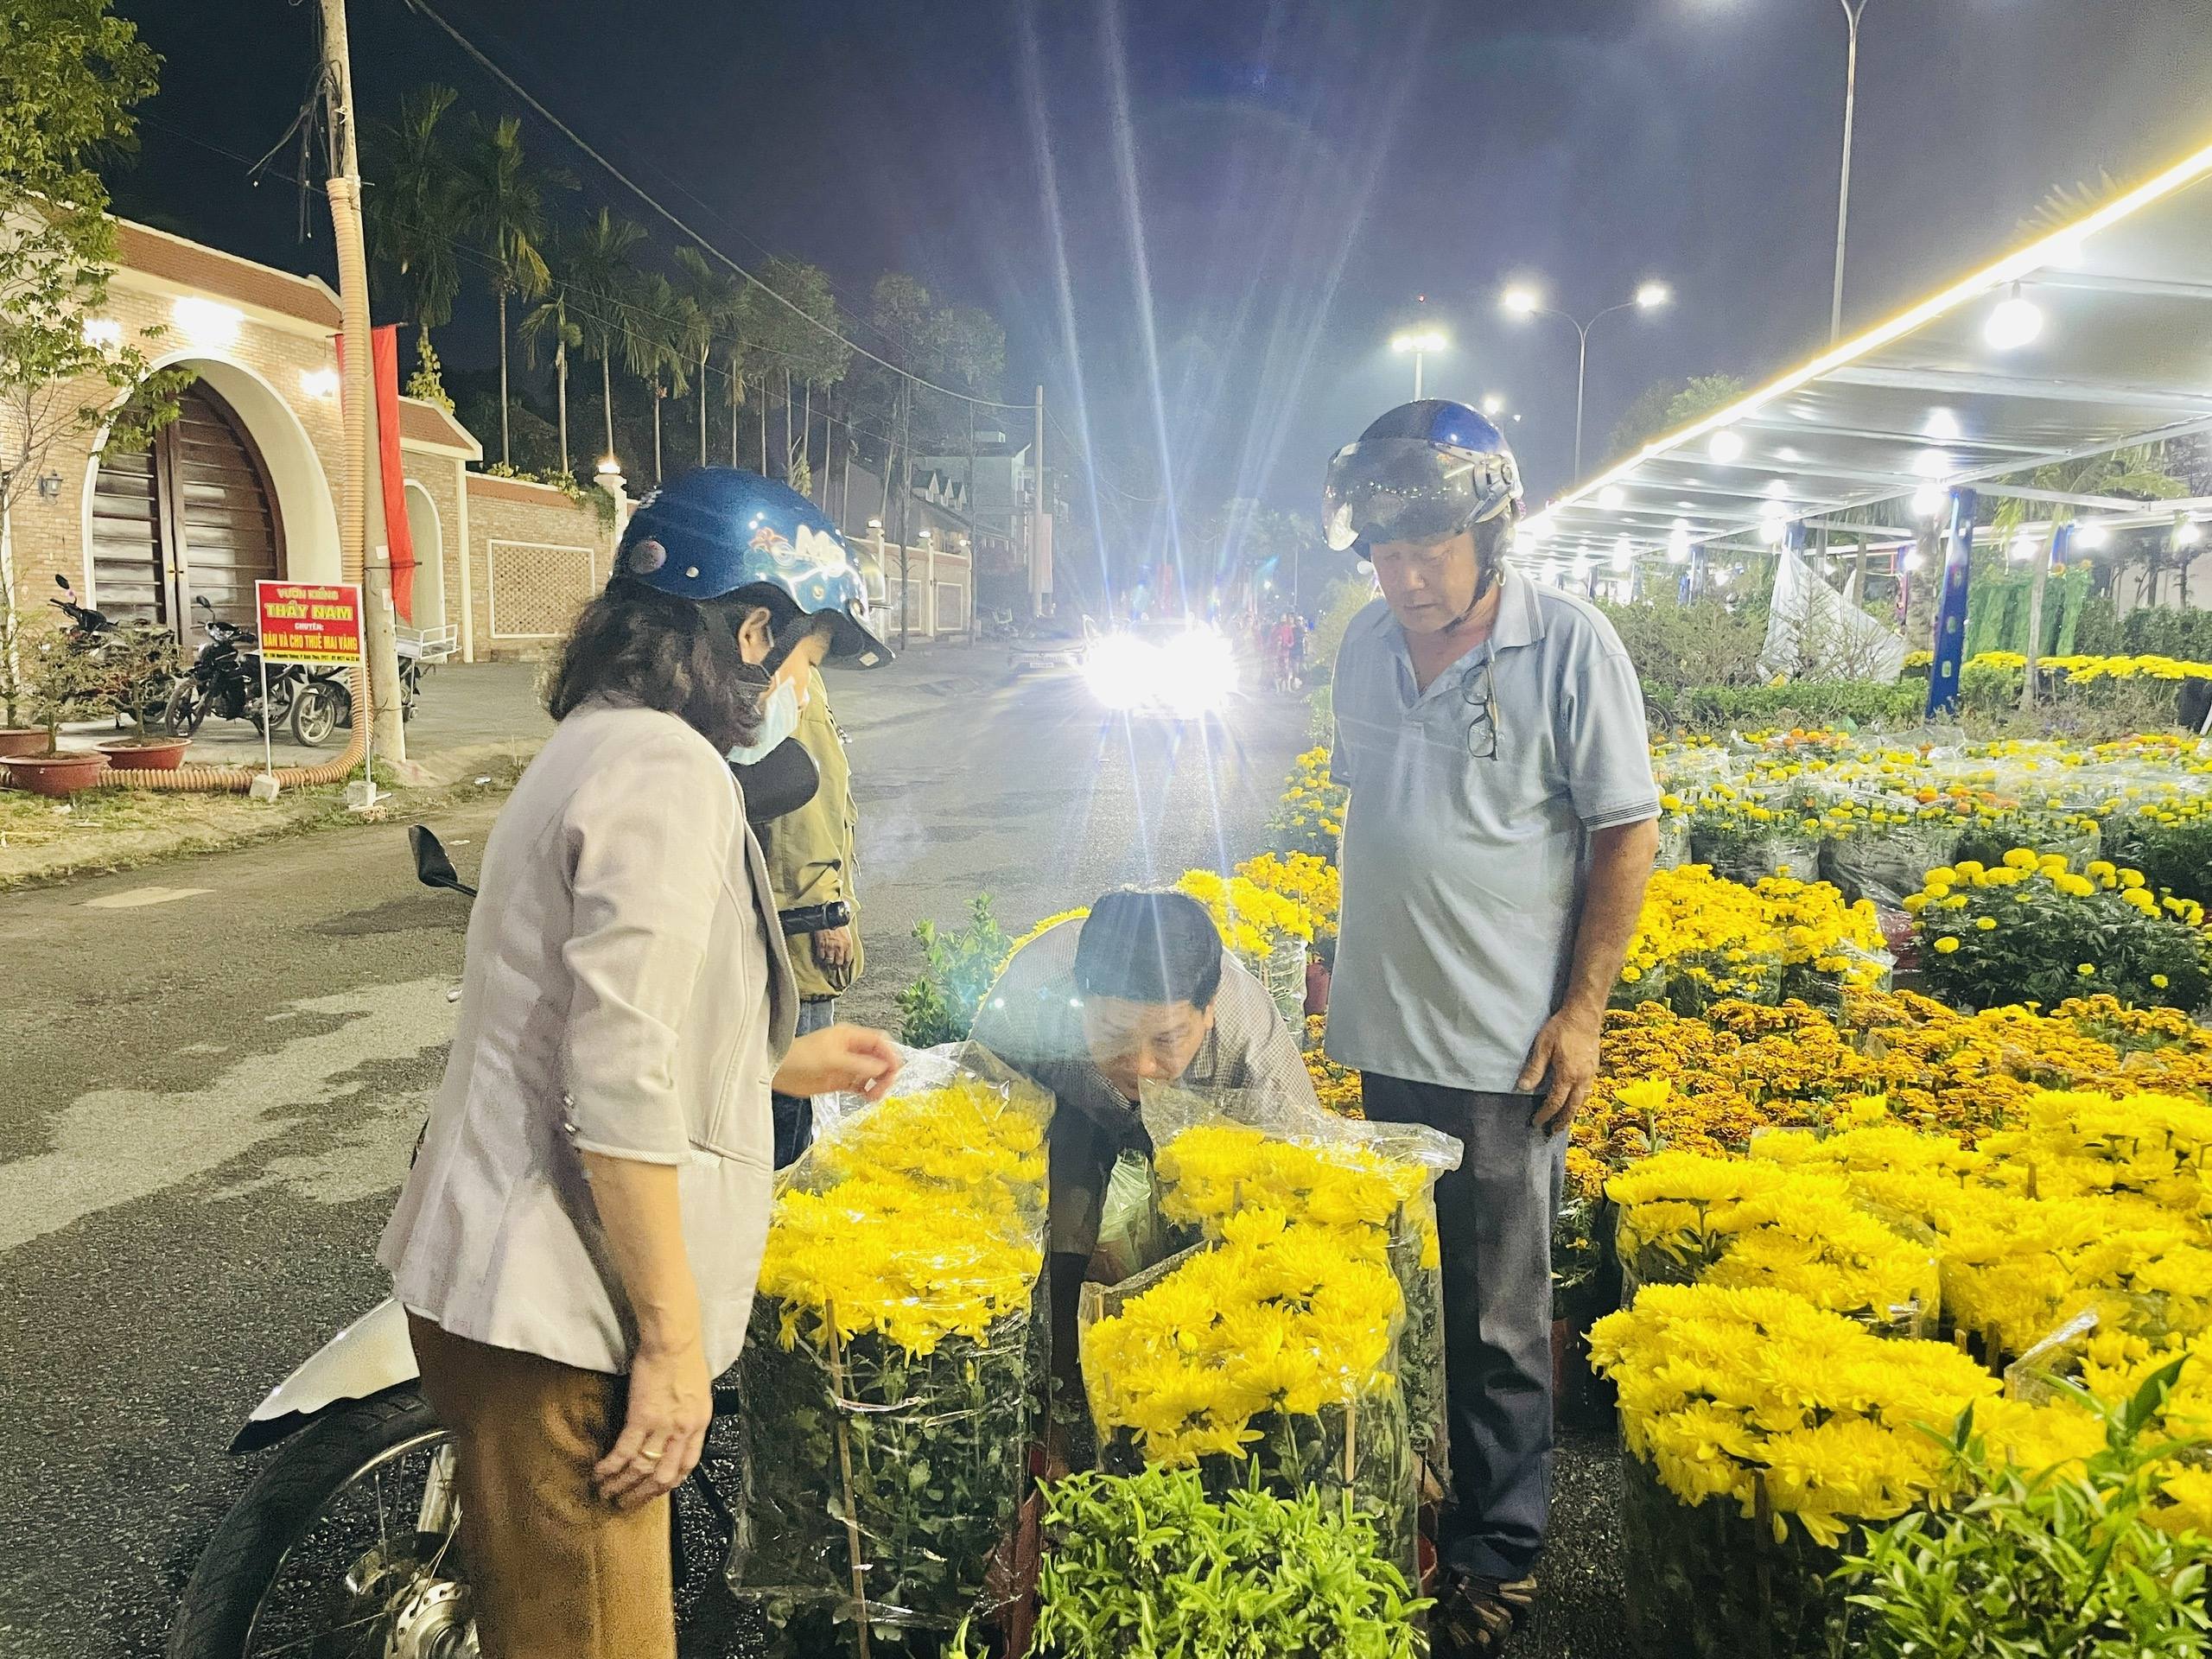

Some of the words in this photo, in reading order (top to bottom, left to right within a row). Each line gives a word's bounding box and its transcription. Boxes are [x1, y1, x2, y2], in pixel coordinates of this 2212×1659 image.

[311, 604, 353, 621] NAM
[263, 631, 277, 647] BÁN
[278, 632, 289, 647] VÀ
[289, 634, 303, 648] CHO
[323, 635, 337, 650] MAI
[339, 633, 358, 651] VÀNG
